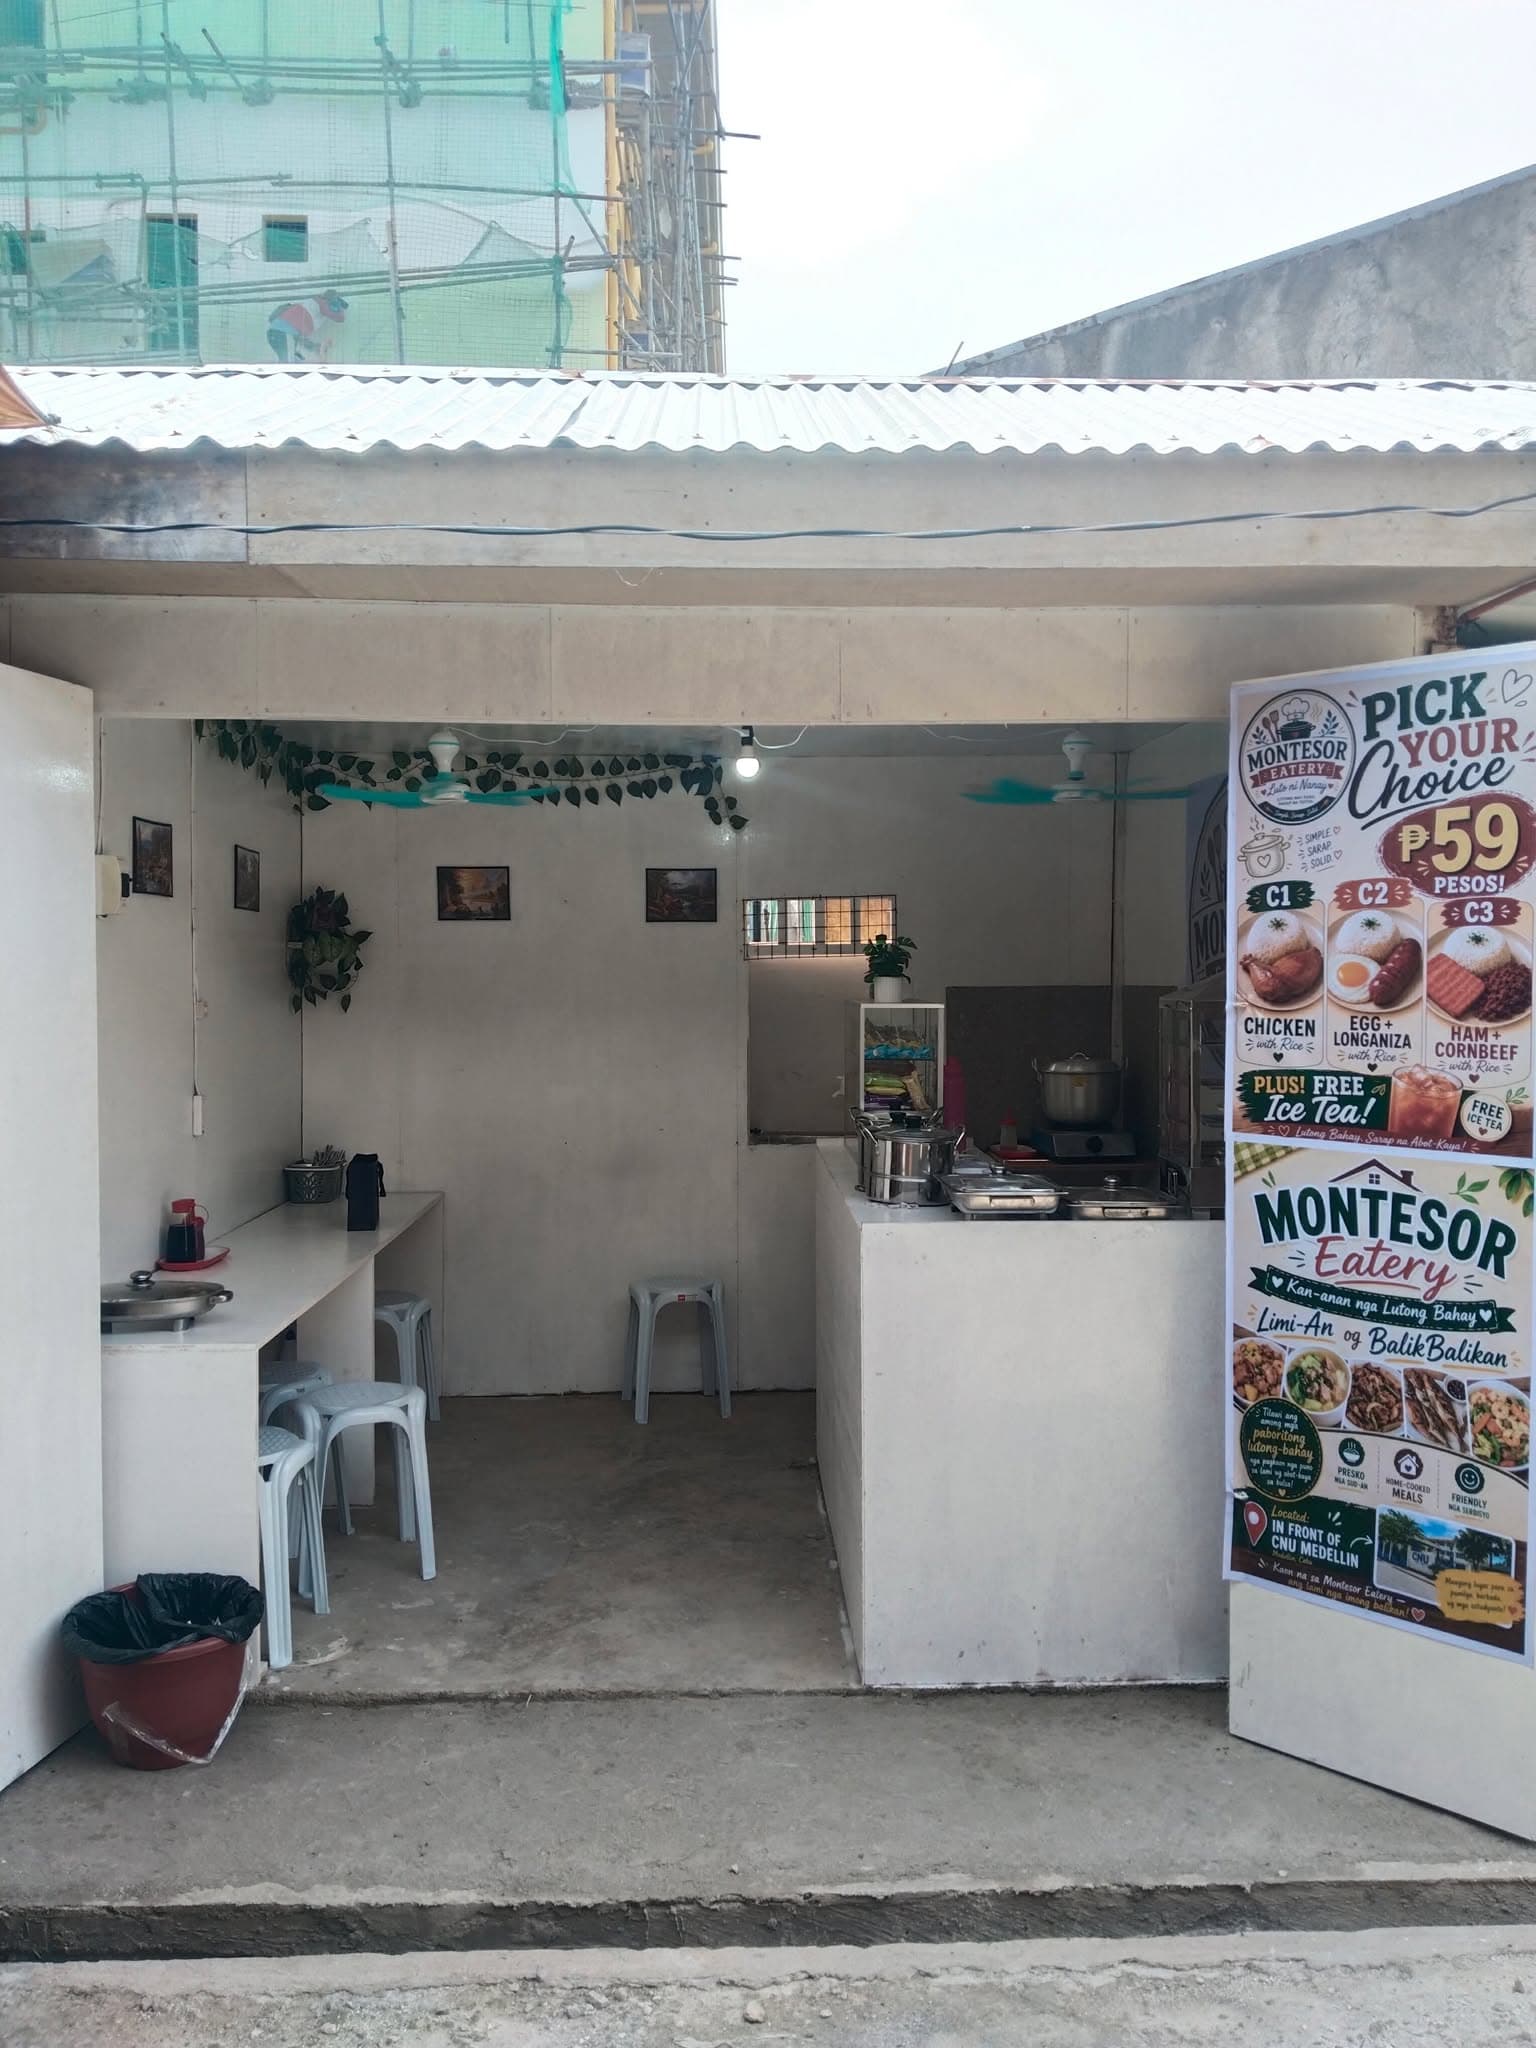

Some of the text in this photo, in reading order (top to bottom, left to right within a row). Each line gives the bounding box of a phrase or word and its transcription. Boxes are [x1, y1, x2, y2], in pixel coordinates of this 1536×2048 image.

[1362, 672, 1487, 742] PICK
[1398, 717, 1519, 768] YOUR
[1247, 740, 1347, 773] MONTESOR
[1270, 762, 1326, 779] EATERY
[1348, 740, 1515, 819] Choice
[1289, 781, 1298, 792] ni
[1358, 882, 1388, 905] C2
[1434, 875, 1505, 894] PESOS!
[1266, 885, 1291, 907] C1
[1464, 901, 1494, 923] C3
[1244, 1017, 1315, 1037] CHICKEN
[1350, 1016, 1393, 1032] EGG +
[1256, 1037, 1304, 1051] with Rice
[1334, 1032, 1412, 1049] LONGANIZA
[1451, 1026, 1502, 1043] HAM +
[1348, 1050, 1397, 1062] with Rice
[1435, 1042, 1519, 1061] CORNBEEF
[1449, 1060, 1500, 1073] with Rice
[1254, 1076, 1365, 1096] PLUS! FREE
[1264, 1095, 1376, 1125] Ice Tea!
[1472, 1100, 1505, 1120] FREE
[1467, 1113, 1503, 1131] ICE TEA
[1296, 1126, 1326, 1141] Lutong
[1365, 1132, 1395, 1147] Sarap
[1254, 1187, 1516, 1279] MONTESOR
[1315, 1236, 1457, 1302] Eatery
[1286, 1278, 1478, 1328] Kan-anan nga Lutong Bahay
[1256, 1307, 1334, 1337] Limi-An
[1343, 1328, 1362, 1350] og
[1285, 1413, 1298, 1424] ang
[1253, 1426, 1306, 1448] paboritong
[1247, 1439, 1315, 1464] lutong-bahay
[1338, 1466, 1365, 1480] PRESKO
[1386, 1477, 1430, 1494] HOME-COOKED
[1392, 1487, 1424, 1504] MEALS
[1451, 1493, 1488, 1509] FRIENDLY
[1272, 1520, 1341, 1547] IN FRONT OF
[1271, 1535, 1359, 1568] CNU MEDELLIN
[1412, 1552, 1429, 1563] CNU
[1296, 1572, 1308, 1580] na
[1311, 1575, 1320, 1583] sa
[1323, 1576, 1362, 1593] Montesor
[1364, 1586, 1393, 1603] Eatery
